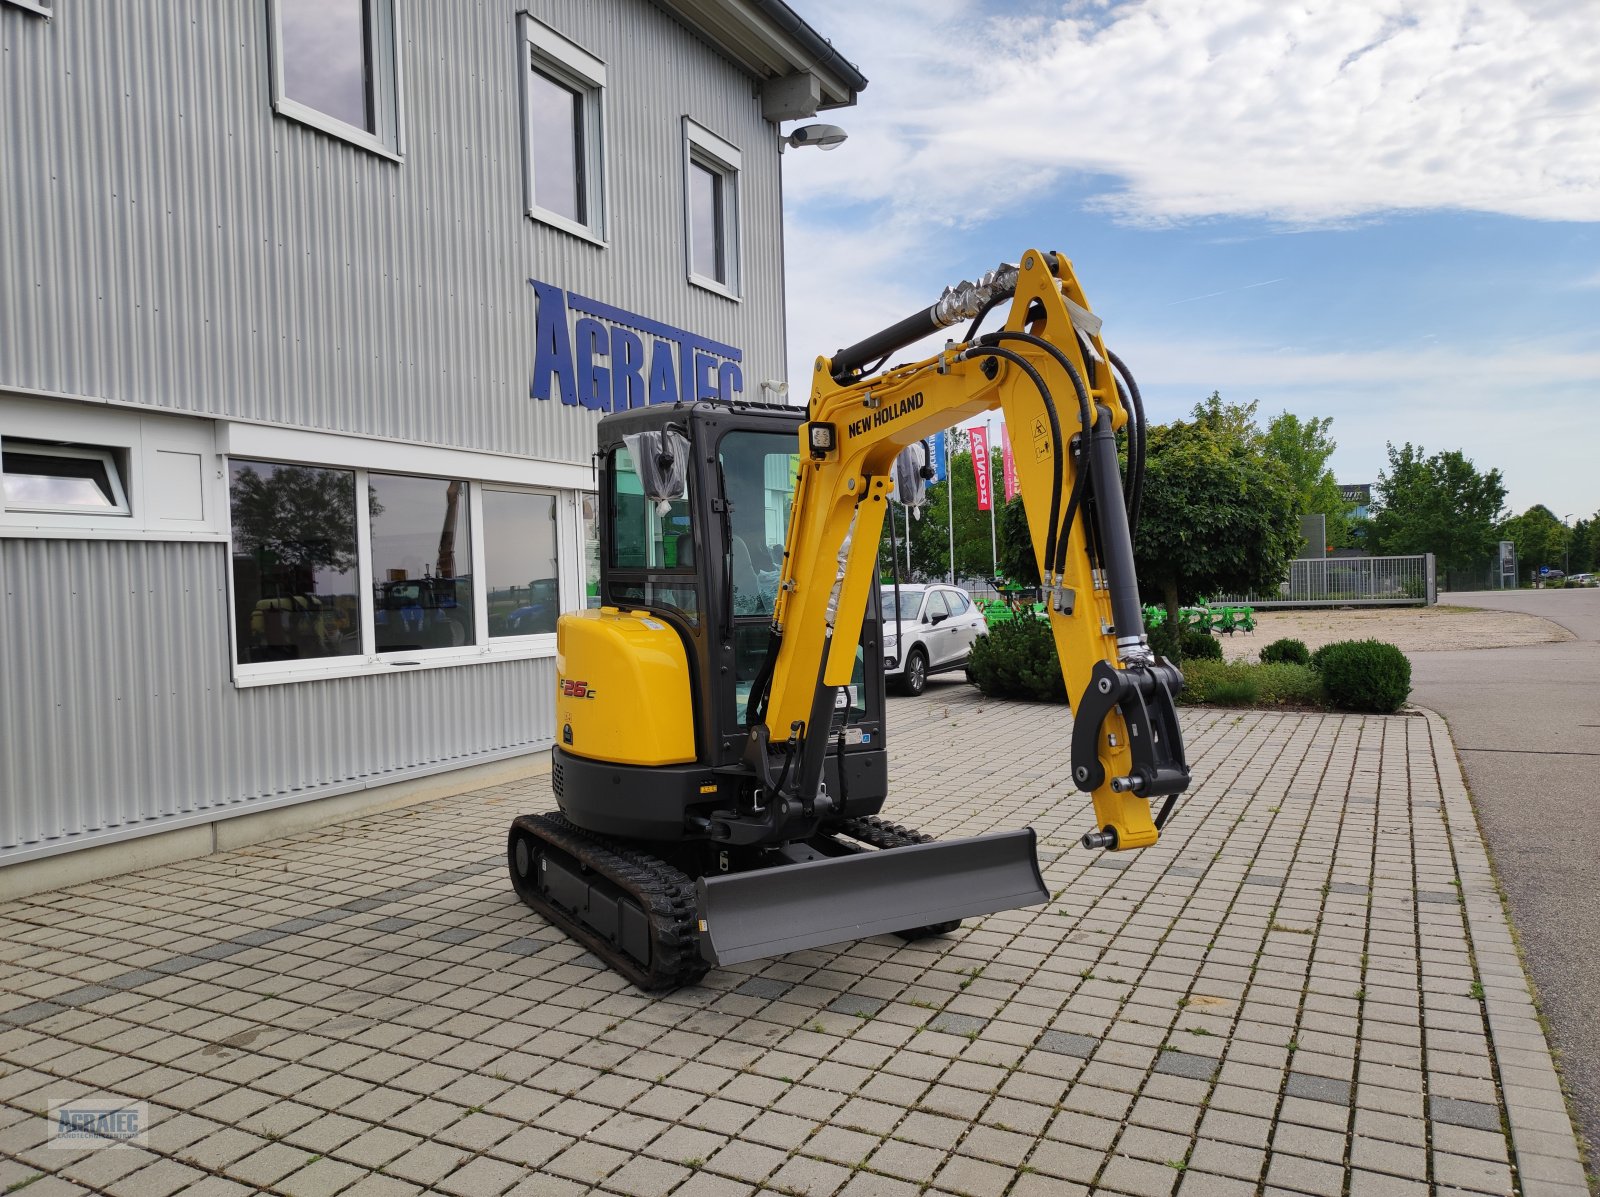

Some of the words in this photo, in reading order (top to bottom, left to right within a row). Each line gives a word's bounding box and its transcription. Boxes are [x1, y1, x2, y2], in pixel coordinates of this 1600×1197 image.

[529, 278, 742, 412] AGRATEC
[848, 415, 872, 438] NEW
[874, 391, 924, 428] HOLLAND
